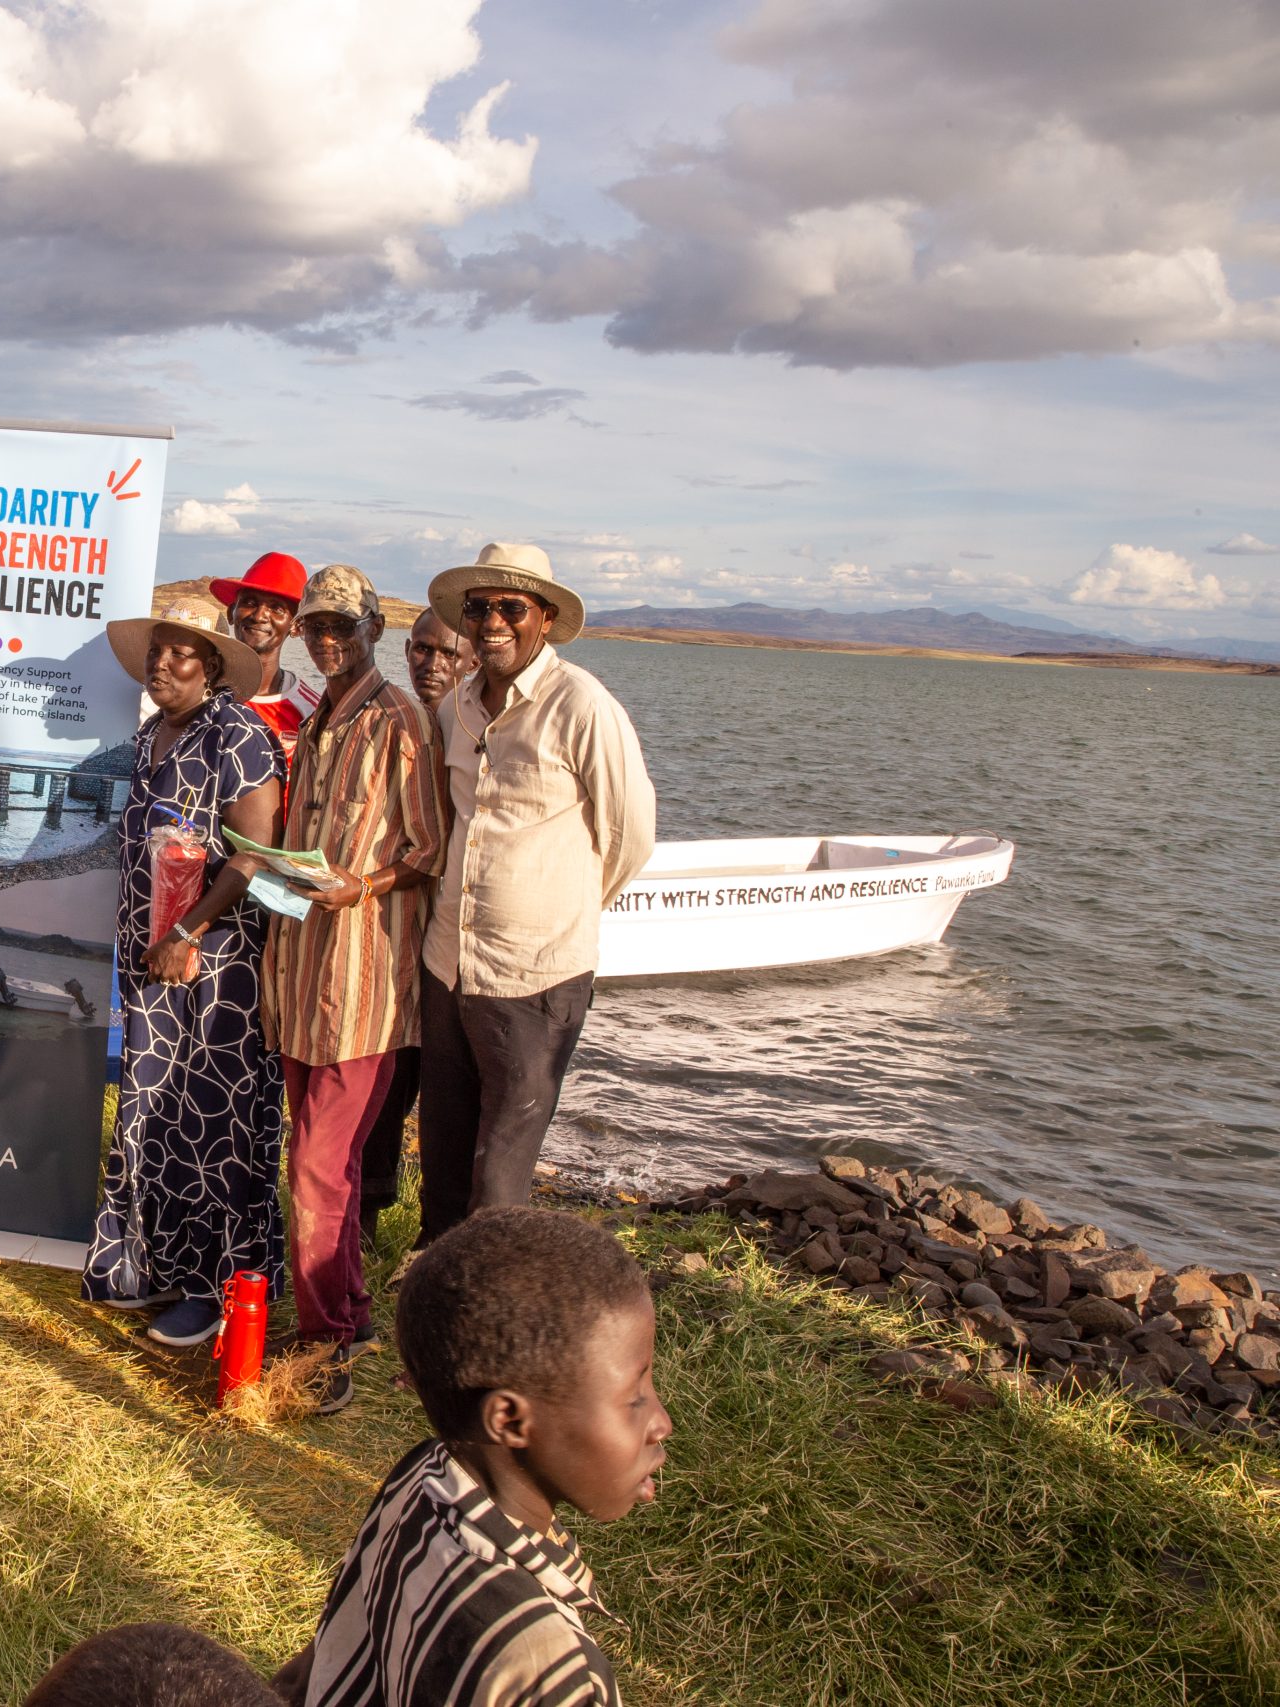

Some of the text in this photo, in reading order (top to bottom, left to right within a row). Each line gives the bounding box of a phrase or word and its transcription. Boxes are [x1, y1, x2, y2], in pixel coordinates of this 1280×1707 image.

[26, 667, 72, 680] Support
[10, 678, 20, 688] in
[23, 680, 41, 691] the
[45, 681, 68, 693] face
[70, 685, 83, 695] of
[12, 692, 38, 704] Lake
[41, 695, 88, 711] Turkana,
[12, 706, 45, 718] home
[47, 709, 86, 723] islands
[608, 869, 996, 913] RITY WITH STRENGTH AND RESILIENCE Pawanka Fund
